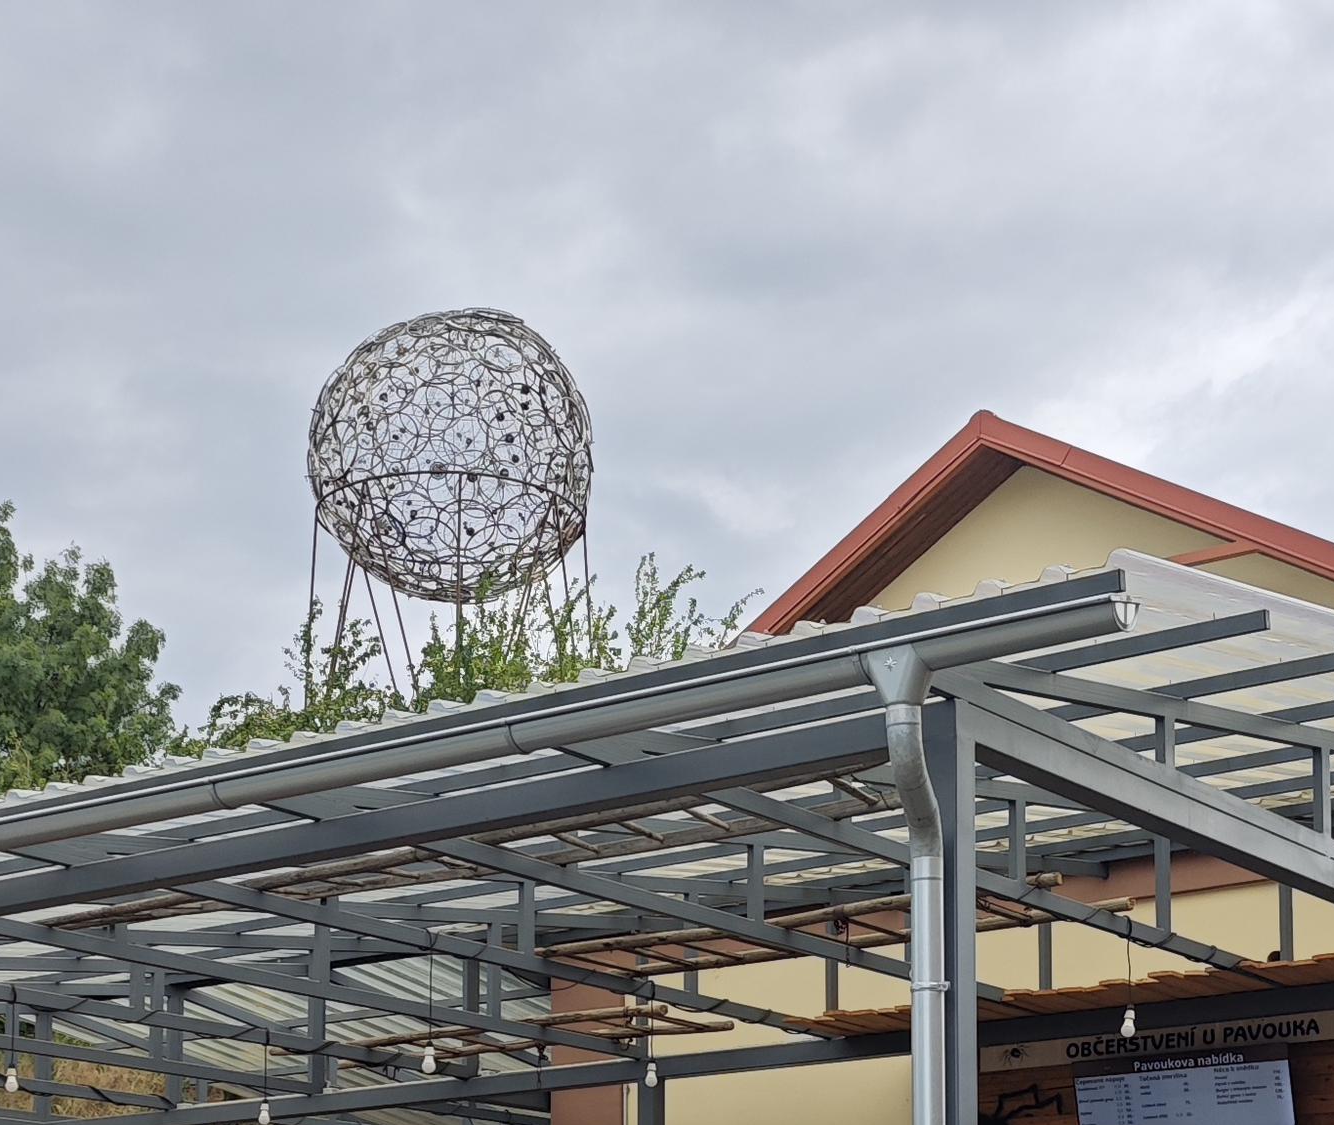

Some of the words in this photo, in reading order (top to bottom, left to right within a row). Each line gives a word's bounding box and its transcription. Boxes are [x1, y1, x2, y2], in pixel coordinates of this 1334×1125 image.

[1067, 1027, 1195, 1059] OBČERSTVENÍ
[1202, 1028, 1216, 1046] U
[1223, 1018, 1320, 1044] PAVOUKA
[1133, 1057, 1195, 1072] Pavoukova
[1197, 1053, 1244, 1066] nabídka
